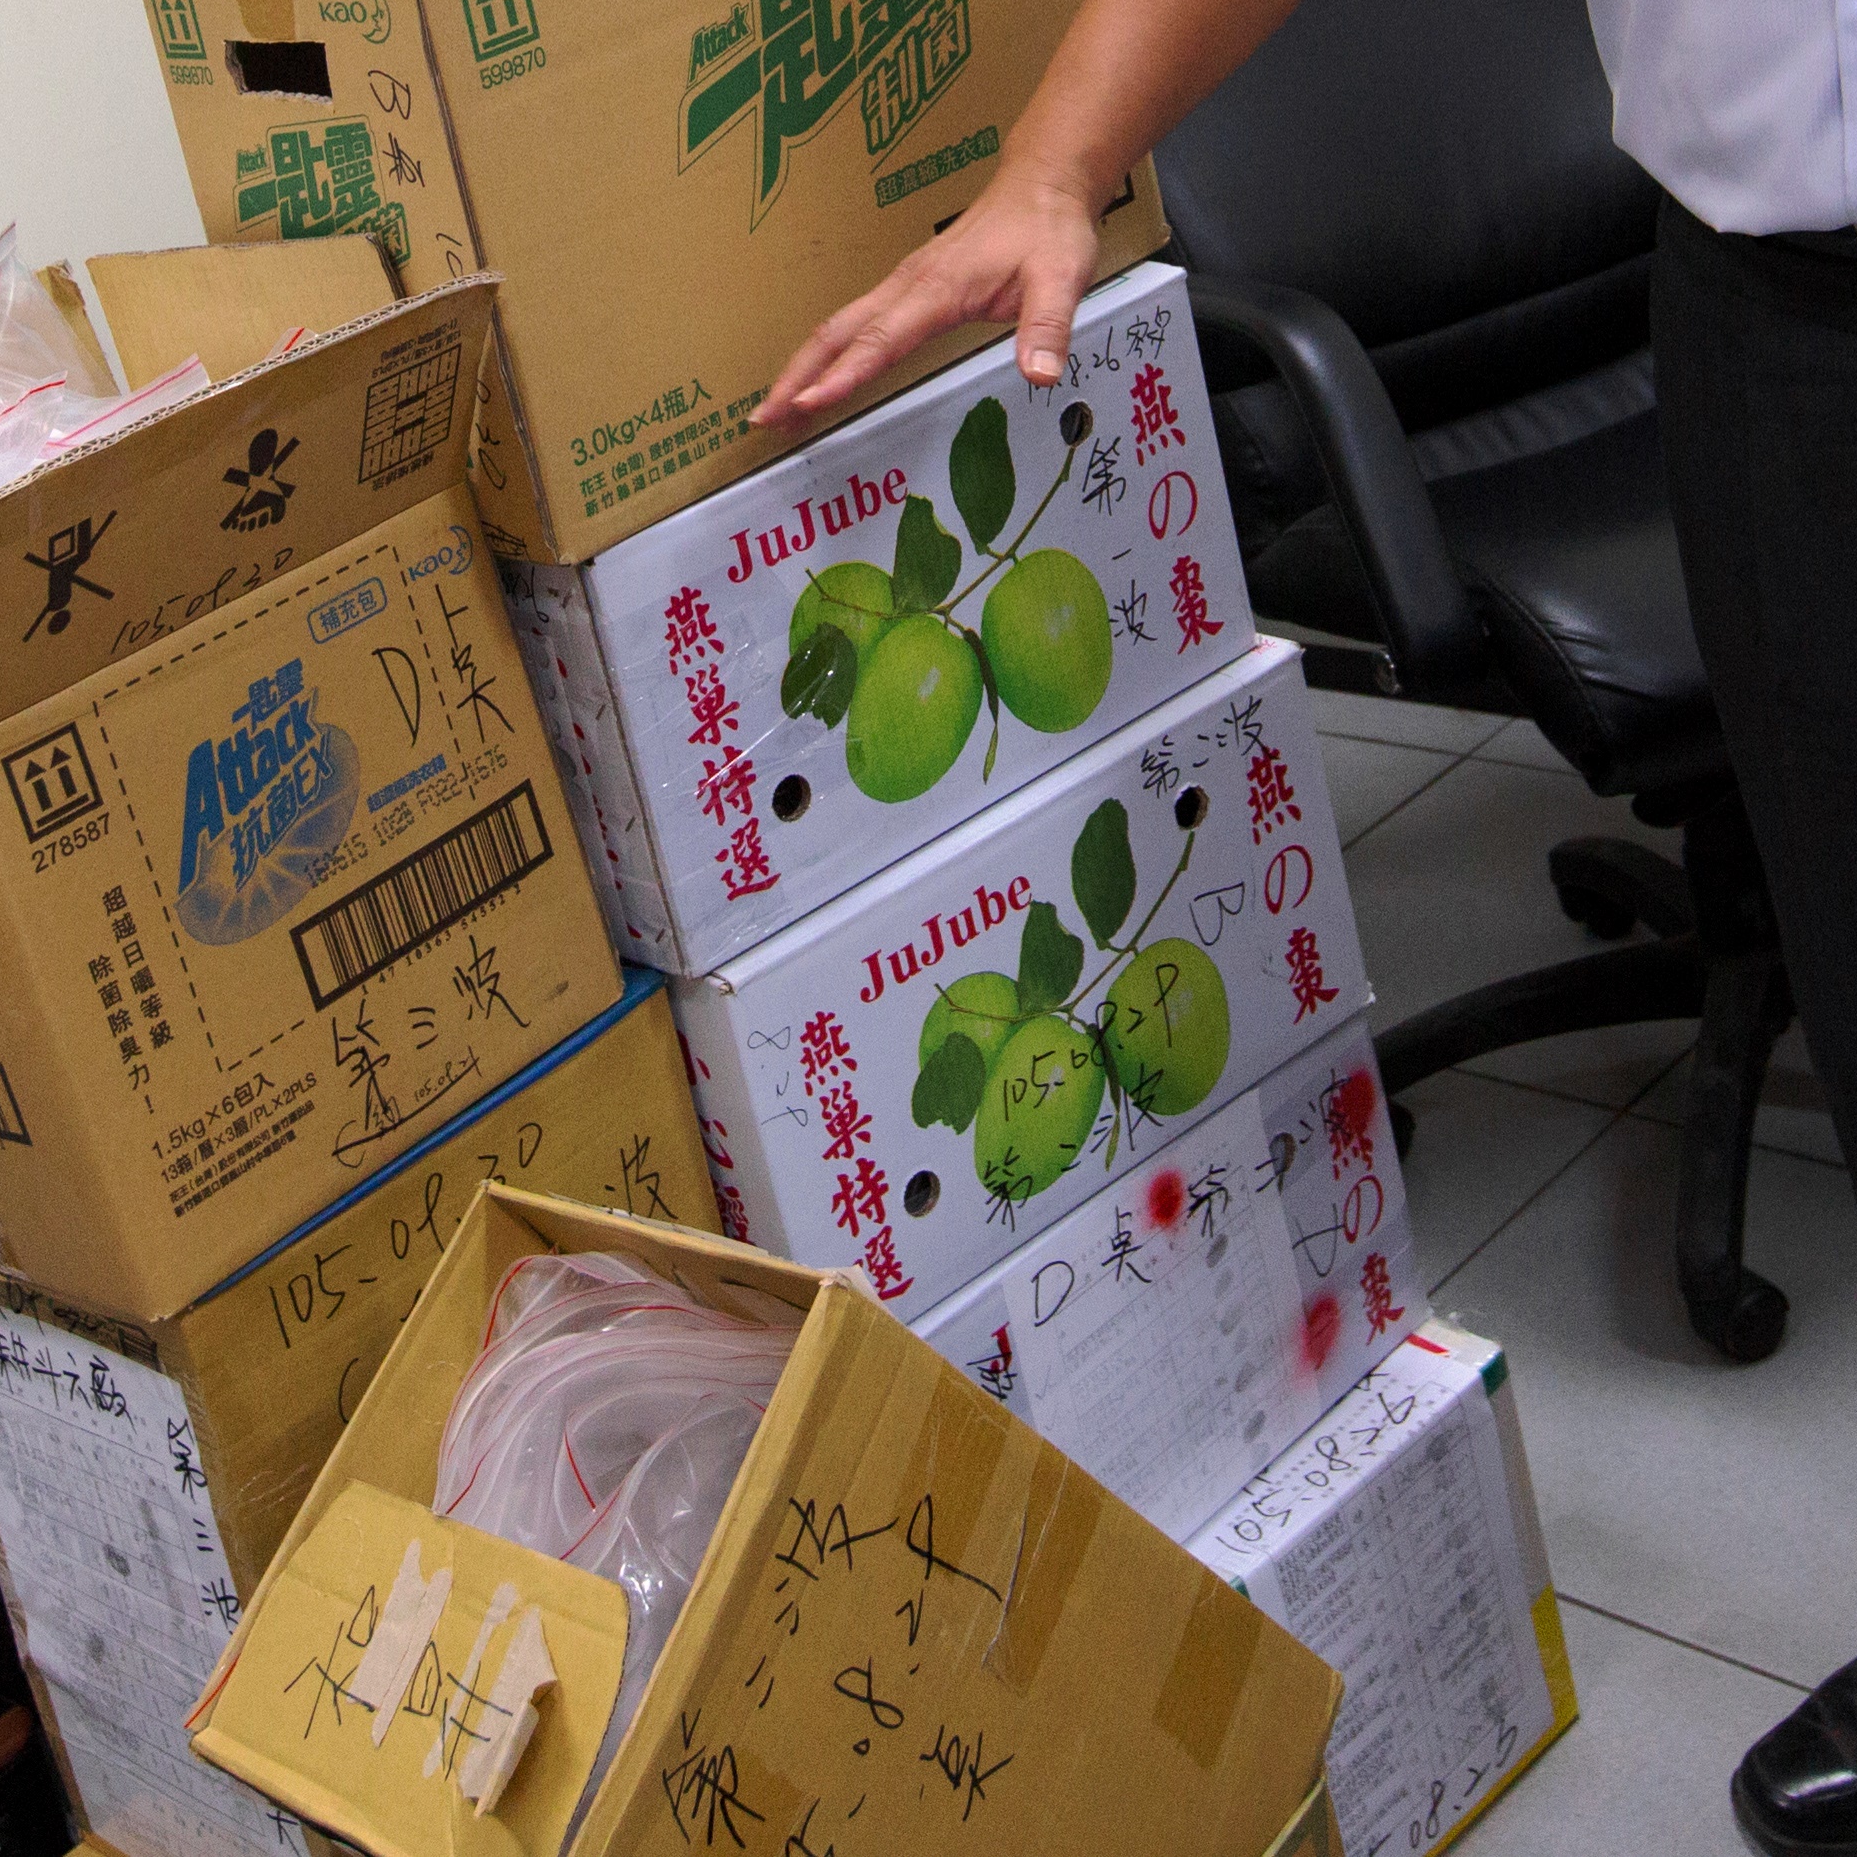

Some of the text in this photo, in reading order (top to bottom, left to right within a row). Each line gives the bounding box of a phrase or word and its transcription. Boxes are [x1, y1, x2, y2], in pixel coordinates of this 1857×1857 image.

[168, 64, 214, 86] 599870
[480, 46, 546, 89] 599870
[688, 3, 754, 84] Attack
[726, 463, 911, 587] JuJube
[318, 586, 380, 634] 補充包
[177, 697, 319, 895] Attack
[662, 585, 781, 904] 燕巢特選
[30, 812, 111, 875] 278587
[101, 884, 175, 1050] 超越日曬等級
[857, 870, 1035, 1008] JuJube
[799, 1010, 916, 1302] 燕巢特選
